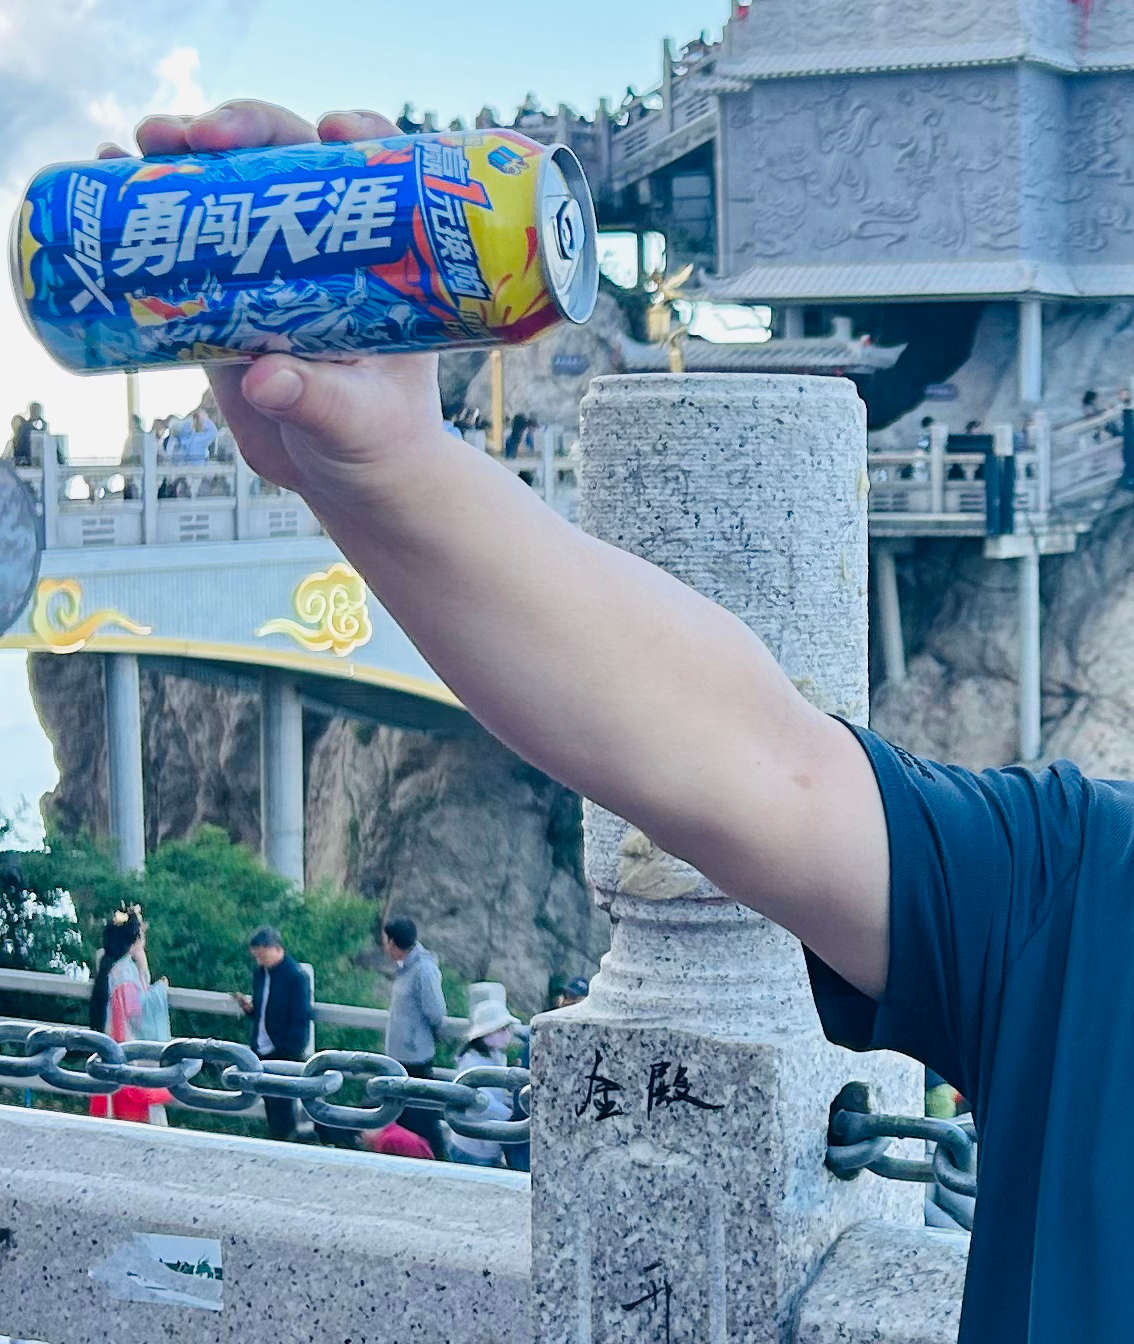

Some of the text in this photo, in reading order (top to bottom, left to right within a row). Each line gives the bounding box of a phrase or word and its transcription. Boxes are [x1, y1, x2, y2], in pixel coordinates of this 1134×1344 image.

[111, 175, 404, 277] 勇闯天涯
[575, 1049, 725, 1122] 金殿
